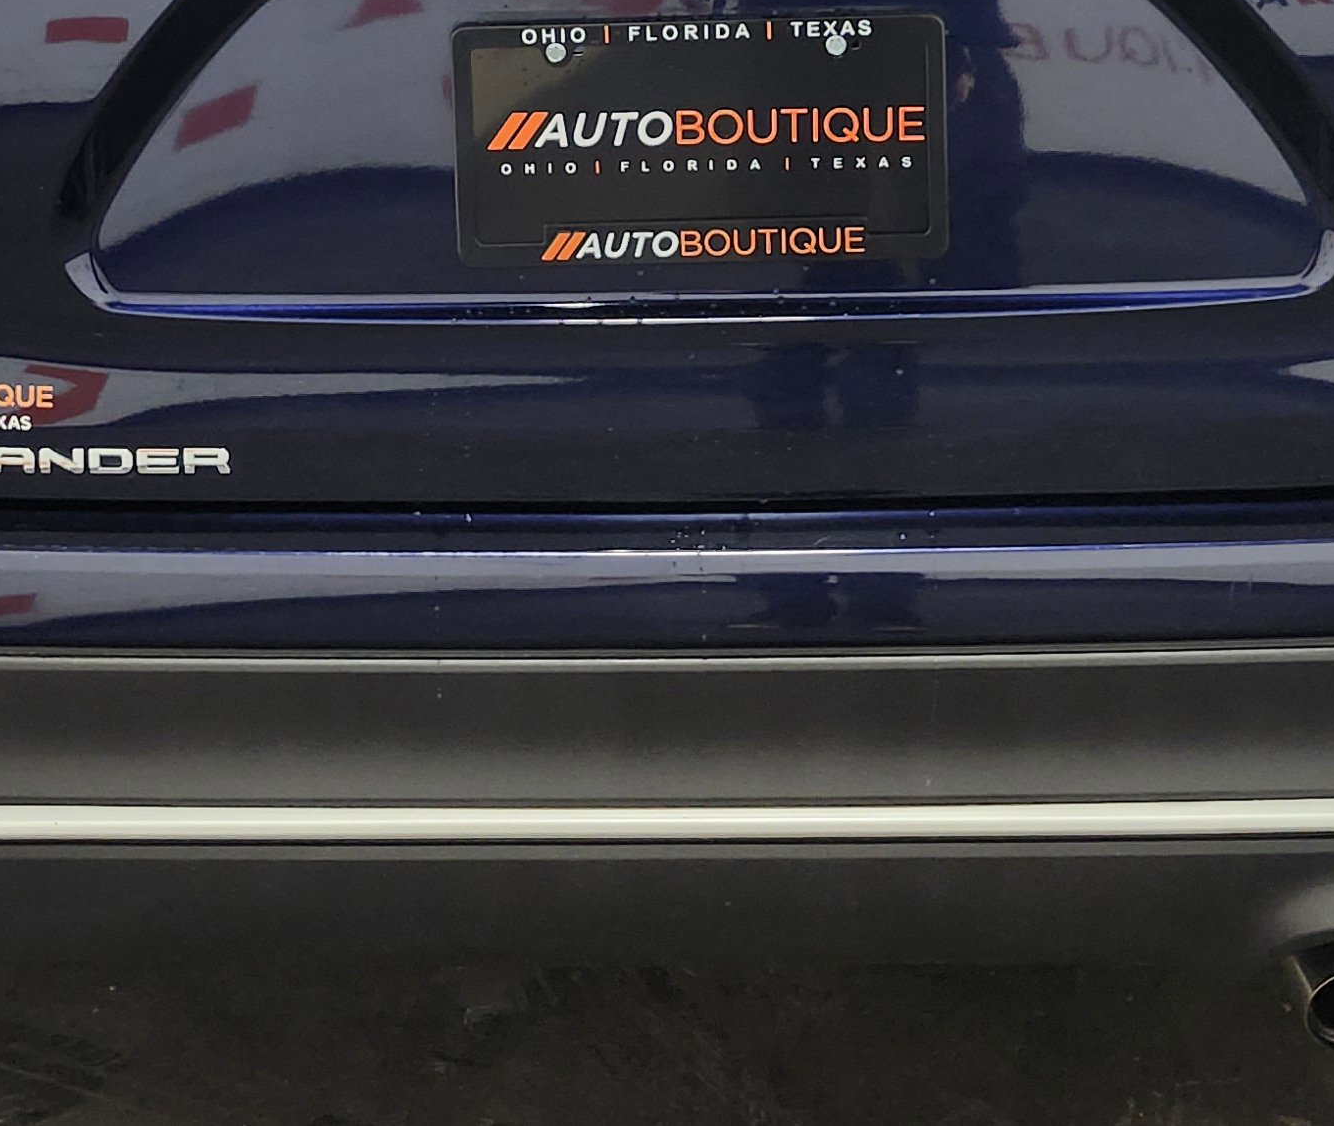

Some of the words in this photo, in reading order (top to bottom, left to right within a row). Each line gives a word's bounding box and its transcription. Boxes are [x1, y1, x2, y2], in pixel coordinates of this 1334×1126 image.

[520, 26, 587, 45] OHIO
[627, 22, 751, 42] FLORIDA
[790, 19, 873, 38] TEXAS
[500, 163, 577, 175] OHIO
[620, 159, 762, 173] FLORIDA
[810, 156, 913, 171] TEXAS
